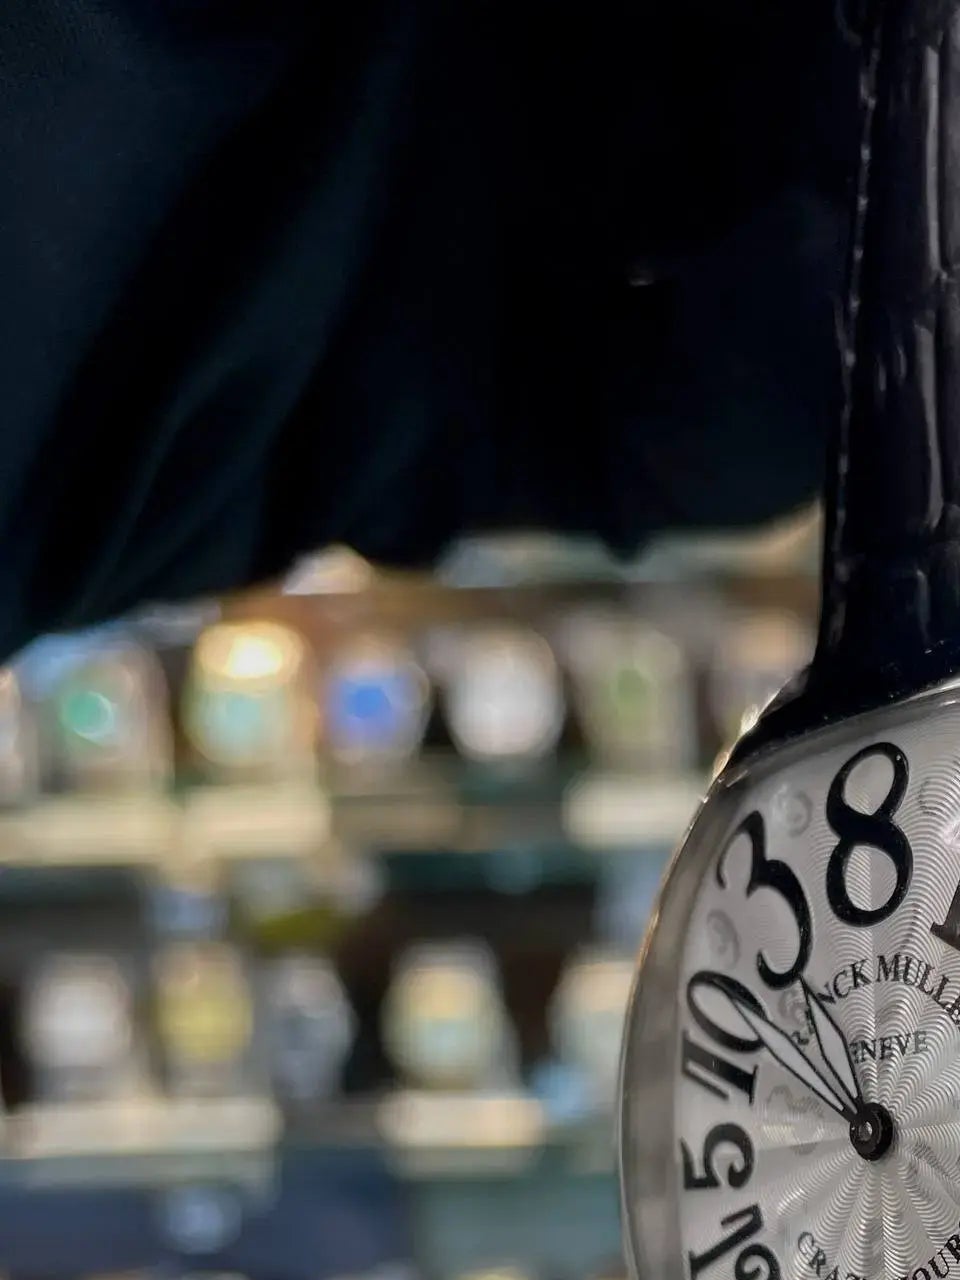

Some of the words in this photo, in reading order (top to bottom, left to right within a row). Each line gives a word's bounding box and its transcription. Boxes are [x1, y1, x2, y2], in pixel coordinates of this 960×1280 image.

[716, 810, 813, 990] 3
[827, 742, 913, 928] 8
[681, 970, 768, 1105] 10
[680, 1122, 755, 1191] 5
